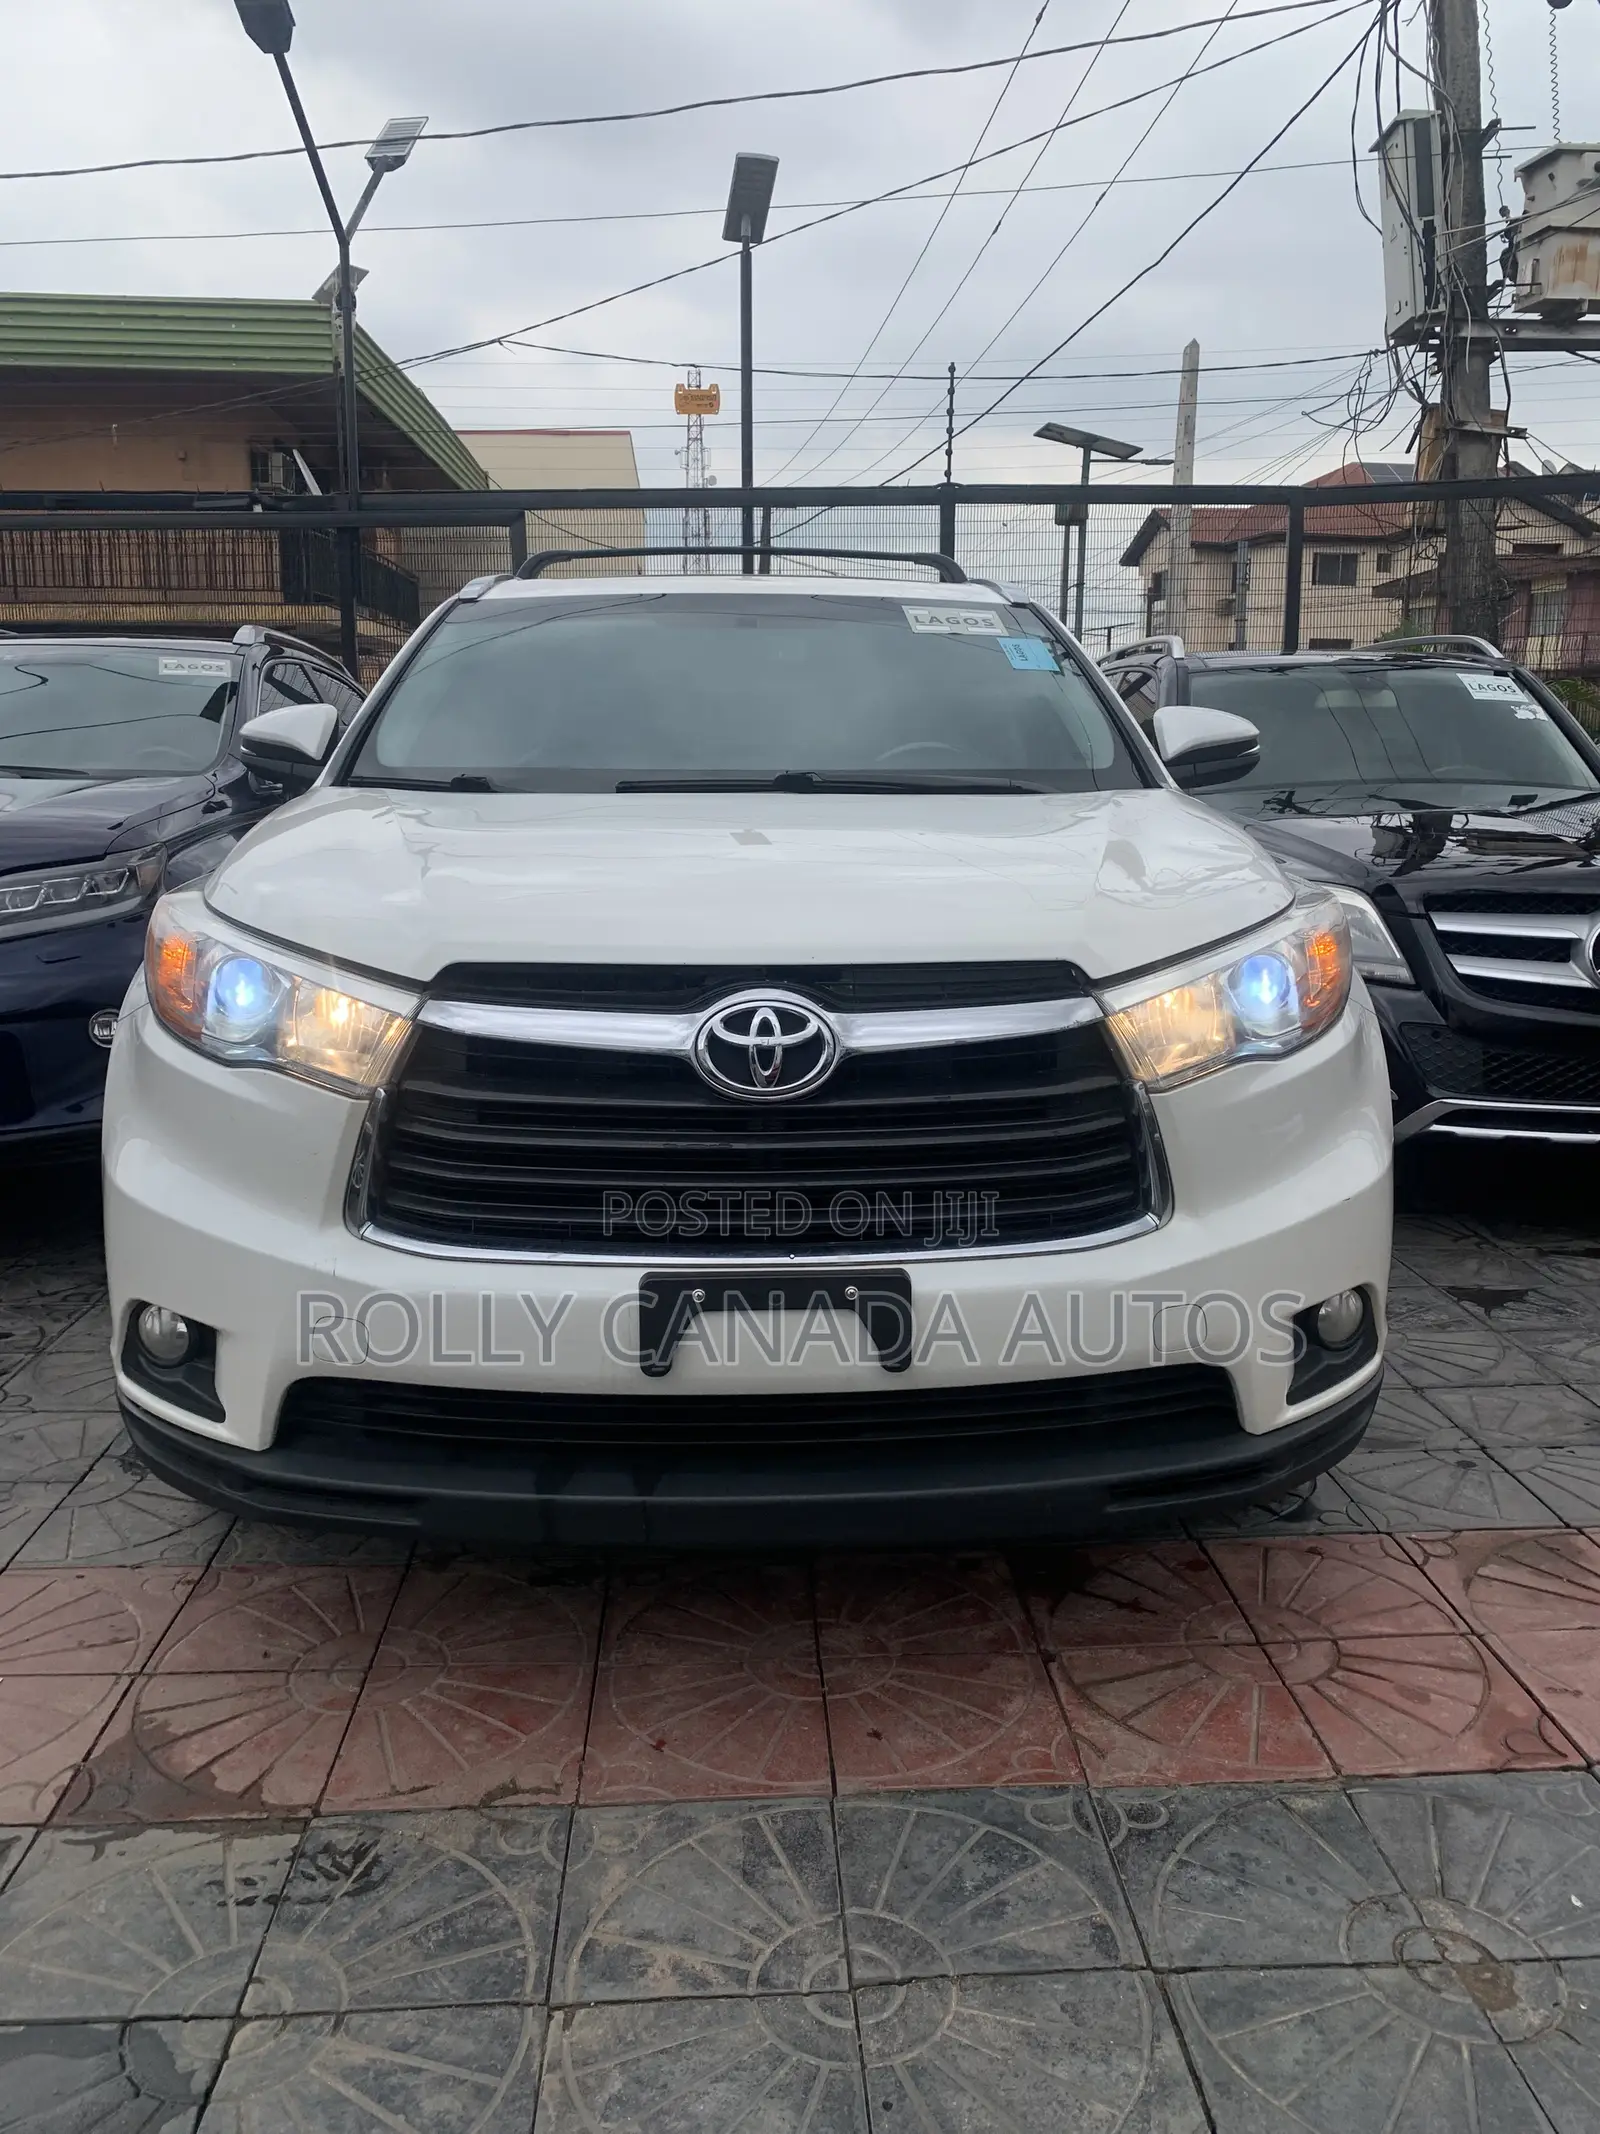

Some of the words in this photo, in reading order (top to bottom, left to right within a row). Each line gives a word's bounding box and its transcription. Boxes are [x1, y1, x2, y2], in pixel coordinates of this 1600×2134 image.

[914, 615, 995, 627] LAGOS
[164, 663, 224, 671] LAGOS
[1468, 682, 1516, 693] LAGOS
